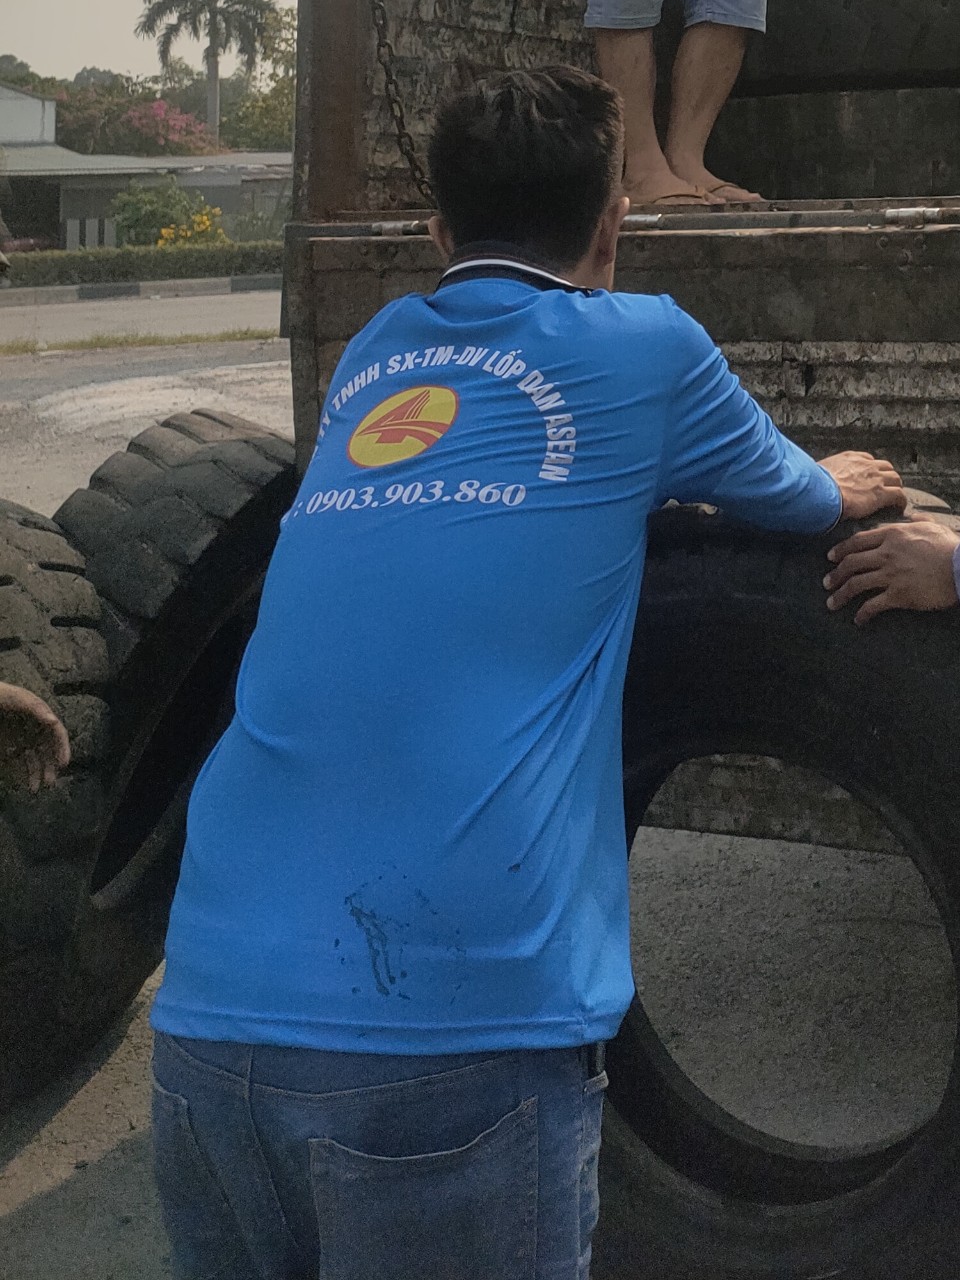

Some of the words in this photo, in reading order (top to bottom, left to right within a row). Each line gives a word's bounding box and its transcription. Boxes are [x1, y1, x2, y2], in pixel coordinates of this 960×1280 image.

[386, 346, 489, 374] SX-TM-DV
[482, 349, 526, 378] LỐP
[331, 362, 380, 410] TNHH
[516, 369, 567, 412] DÁN
[538, 413, 577, 482] ASEAN
[306, 480, 526, 514] 0903.903.860
